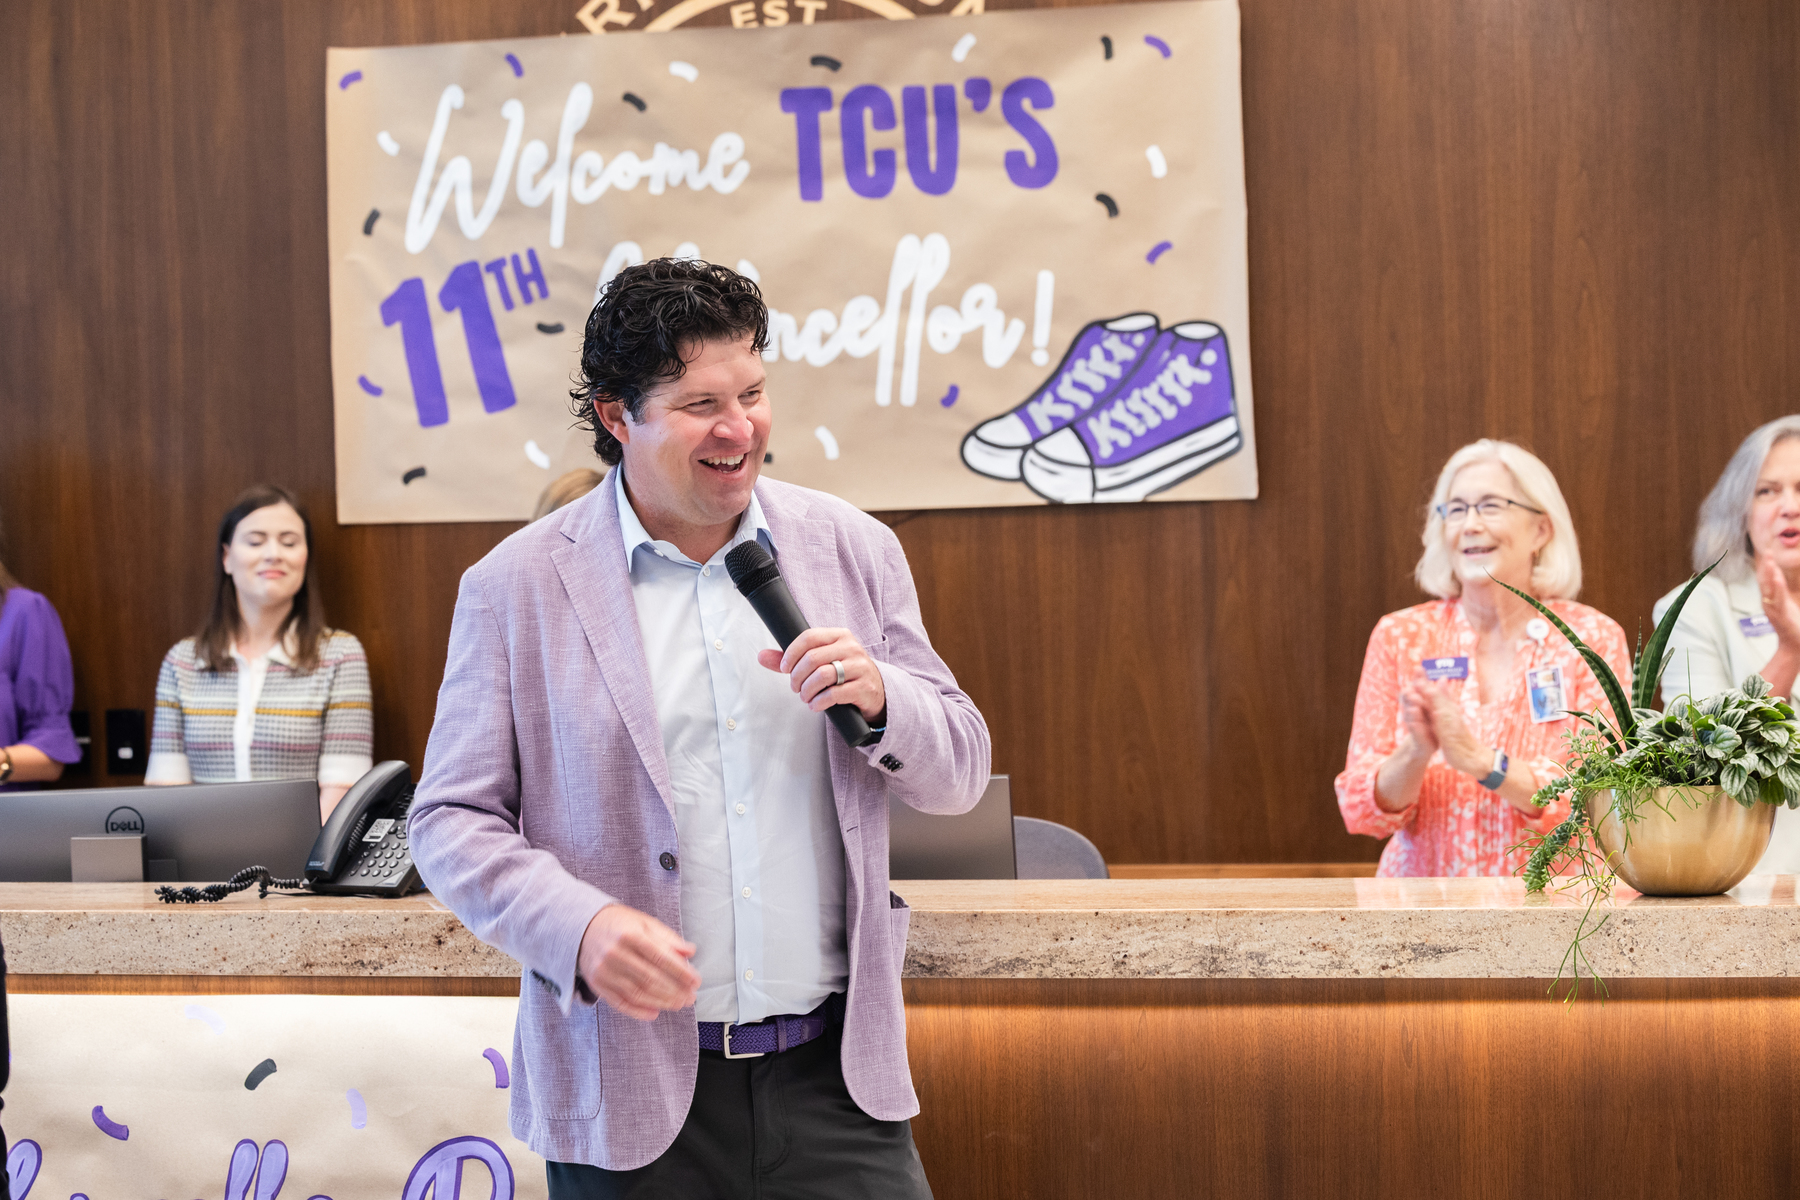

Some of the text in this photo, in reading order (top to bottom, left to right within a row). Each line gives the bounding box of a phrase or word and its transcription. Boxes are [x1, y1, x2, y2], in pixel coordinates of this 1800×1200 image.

[730, 0, 828, 29] EST
[404, 76, 1059, 254] Welcome TCU'S
[592, 232, 1056, 408] ncellor!
[110, 820, 140, 832] DELL
